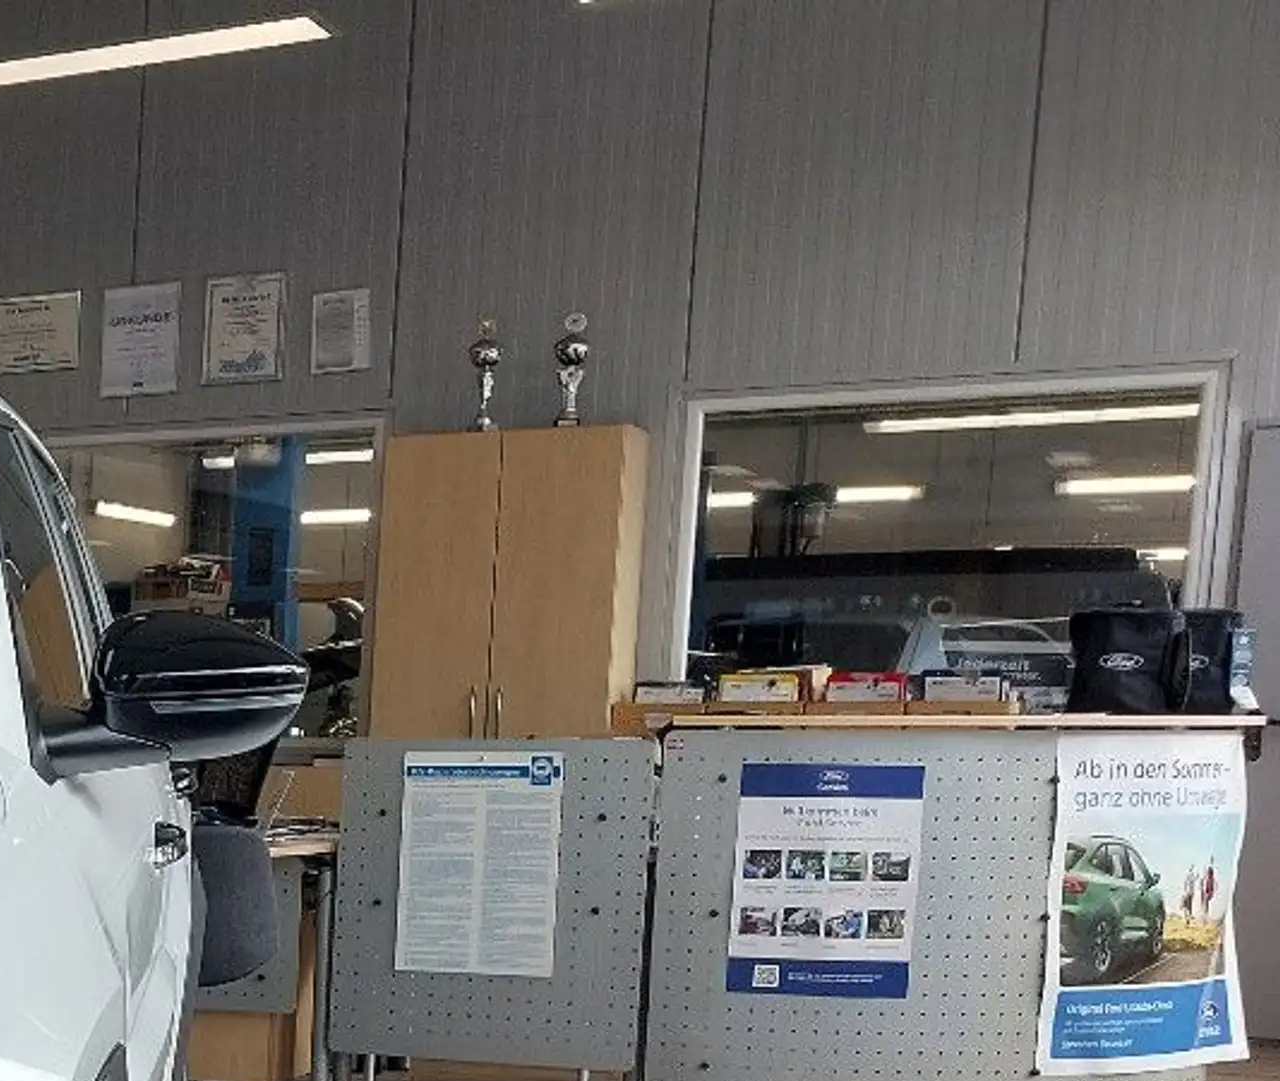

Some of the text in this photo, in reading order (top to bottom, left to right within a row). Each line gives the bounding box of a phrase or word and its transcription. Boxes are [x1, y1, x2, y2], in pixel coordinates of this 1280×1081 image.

[1074, 758, 1102, 779] Ab
[1109, 757, 1128, 779] in
[1133, 757, 1167, 779] den
[1075, 790, 1123, 812] ganz
[1129, 788, 1173, 808] ohne
